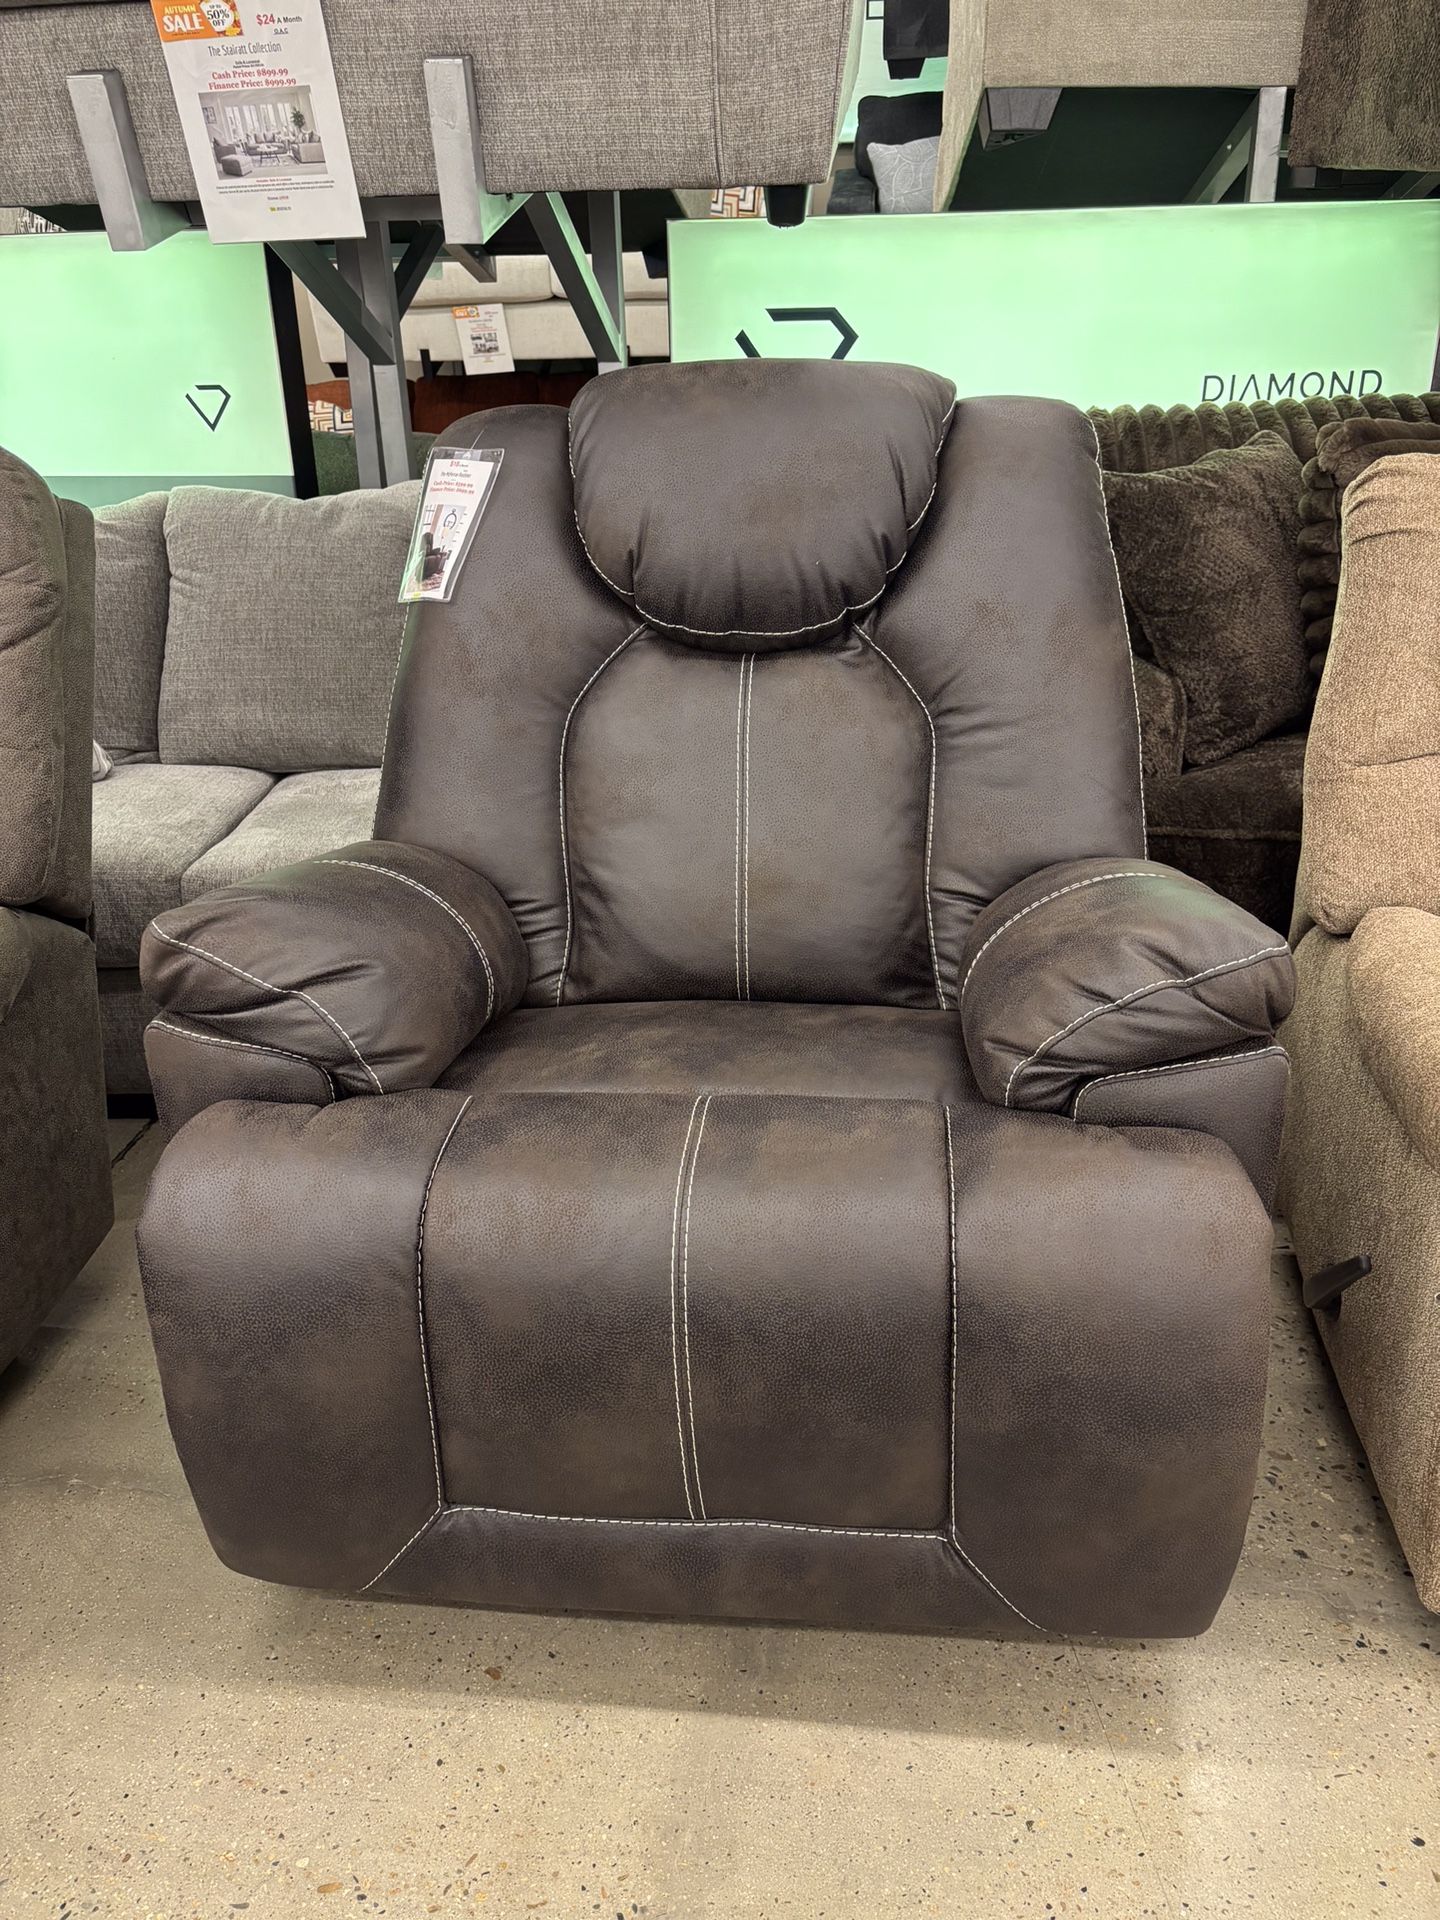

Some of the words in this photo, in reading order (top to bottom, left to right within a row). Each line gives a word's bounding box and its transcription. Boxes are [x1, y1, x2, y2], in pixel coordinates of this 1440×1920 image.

[164, 4, 196, 14] AUTUMN
[207, 8, 230, 20] 50%
[162, 13, 204, 32] SALE
[212, 18, 226, 26] OFF
[256, 13, 275, 26] $24
[208, 46, 221, 57] The
[248, 41, 282, 55] Collection
[212, 71, 231, 80] Cash
[233, 69, 255, 79] Price:
[256, 68, 288, 77] $899.99
[208, 81, 240, 91] Finance
[241, 79, 263, 89] Price:
[265, 78, 297, 87] $999.99
[1201, 369, 1383, 402] DIAMOND
